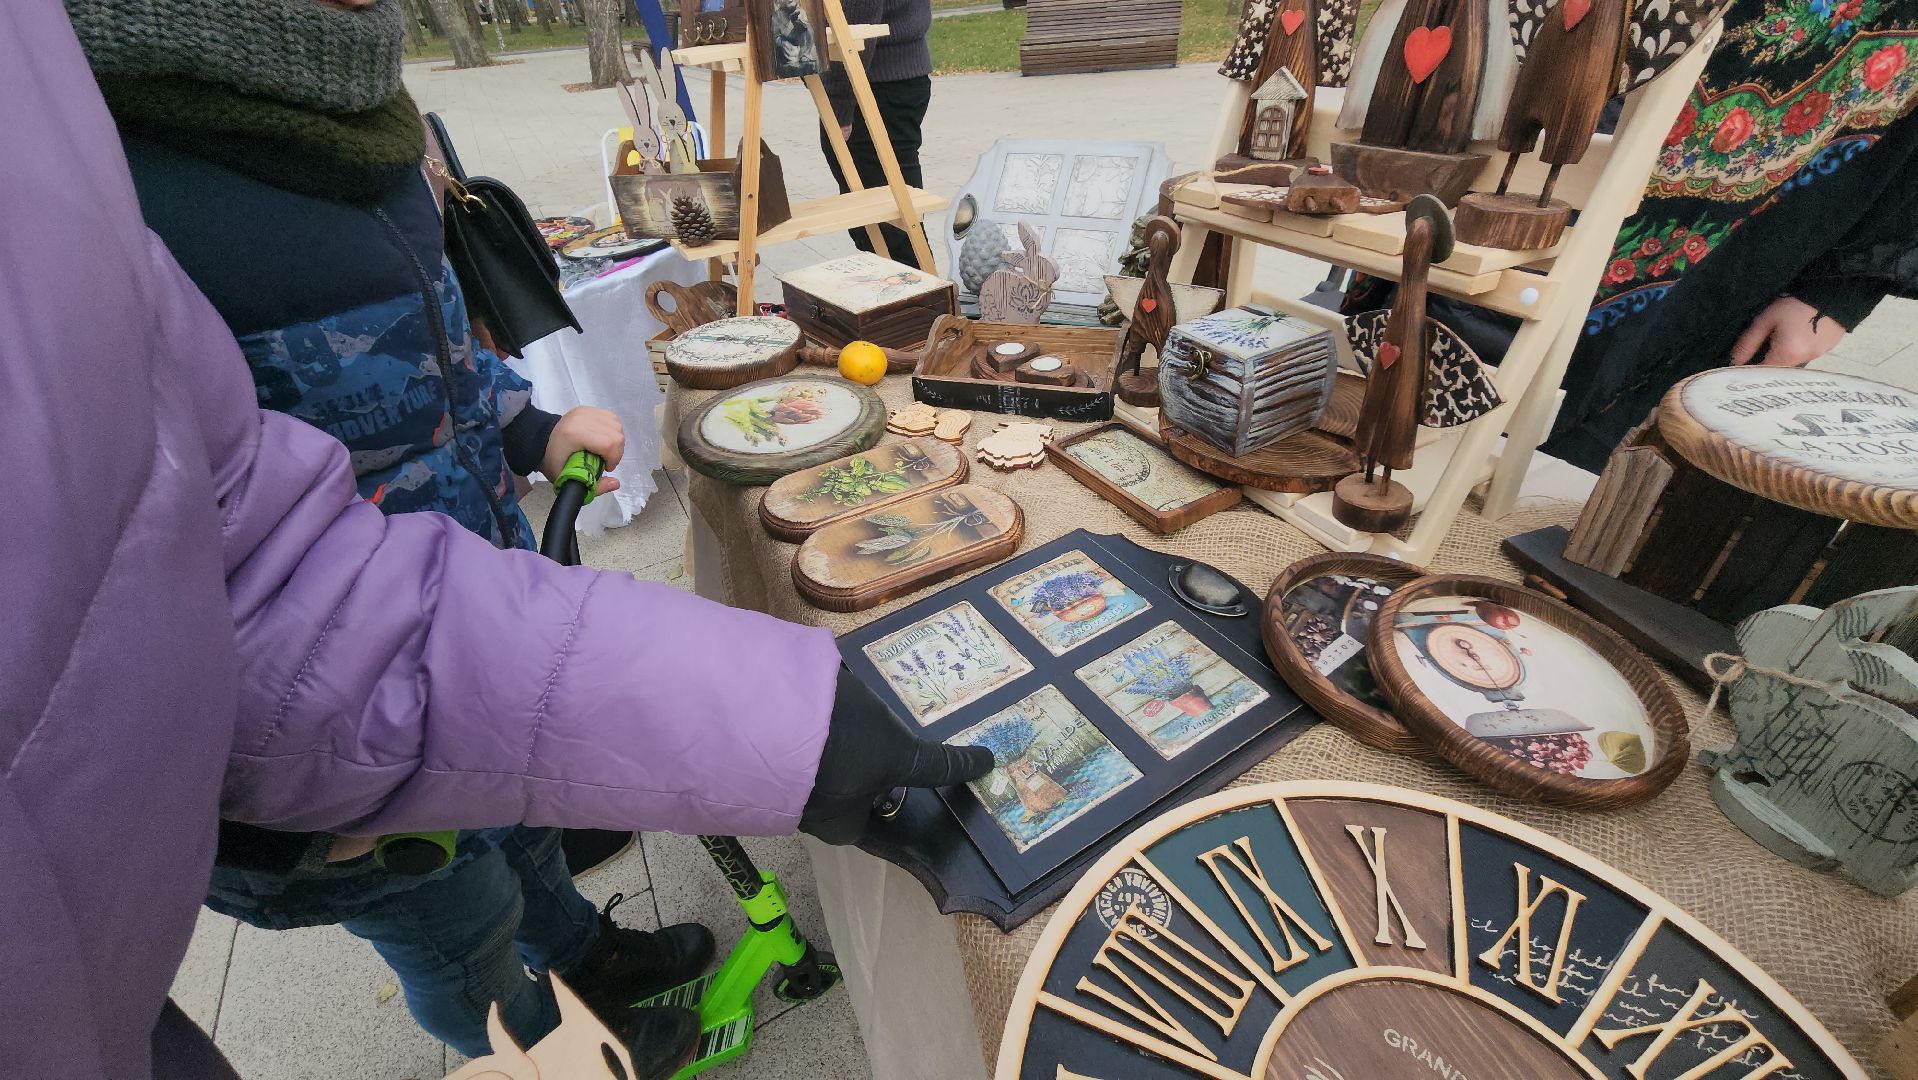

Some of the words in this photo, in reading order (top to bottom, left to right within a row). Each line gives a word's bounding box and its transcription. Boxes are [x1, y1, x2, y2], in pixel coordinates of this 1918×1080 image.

[1197, 836, 1334, 973] IX
[1346, 825, 1427, 950] X
[1478, 862, 1588, 1006] XI
[1075, 901, 1257, 1062] VIII
